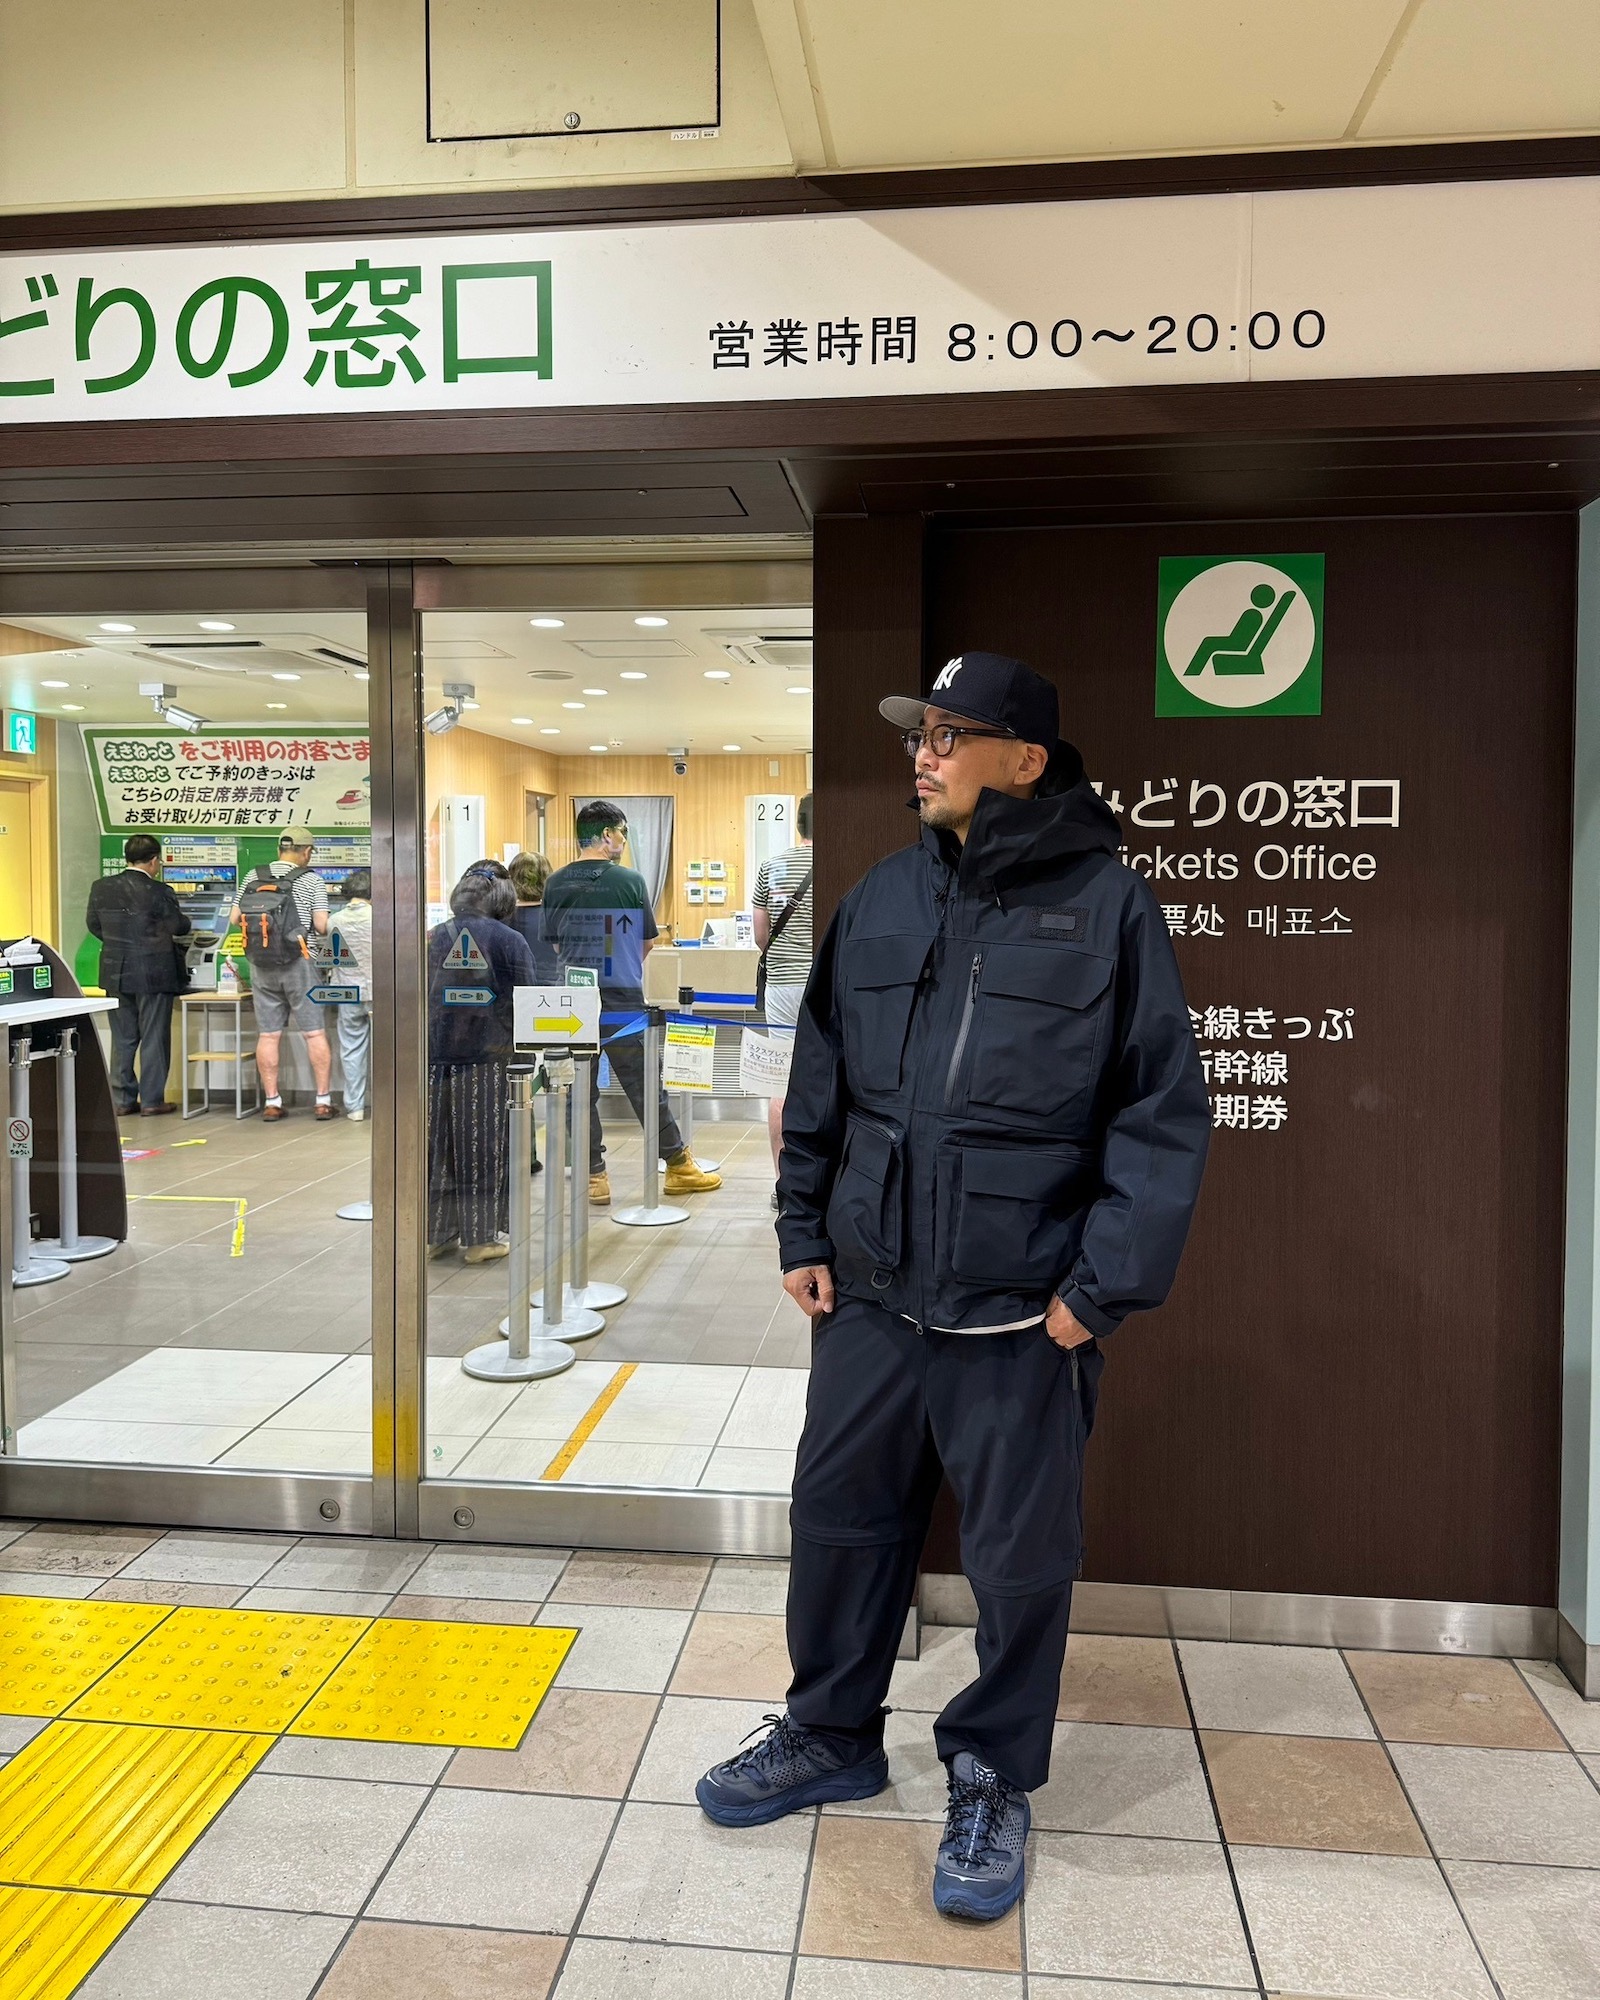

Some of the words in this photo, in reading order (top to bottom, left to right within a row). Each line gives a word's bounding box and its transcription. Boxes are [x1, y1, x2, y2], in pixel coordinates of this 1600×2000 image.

[708, 315, 917, 370] 営業時間
[932, 656, 963, 690] NY
[104, 741, 175, 761] えきねっと
[179, 740, 370, 762] をご利用のお客さま
[109, 765, 171, 783] えきねっと
[175, 765, 316, 781] でご予約のきっぷは
[121, 786, 301, 803] こちらの指定席券売機で
[758, 803, 765, 821] 2
[775, 803, 784, 821] 2
[1118, 845, 1240, 880] ickets
[1253, 844, 1378, 881] Office
[1247, 904, 1353, 937] 매표소
[450, 993, 483, 1001] 自動
[537, 994, 573, 1008] 入口
[1207, 1093, 1289, 1131] 期券
